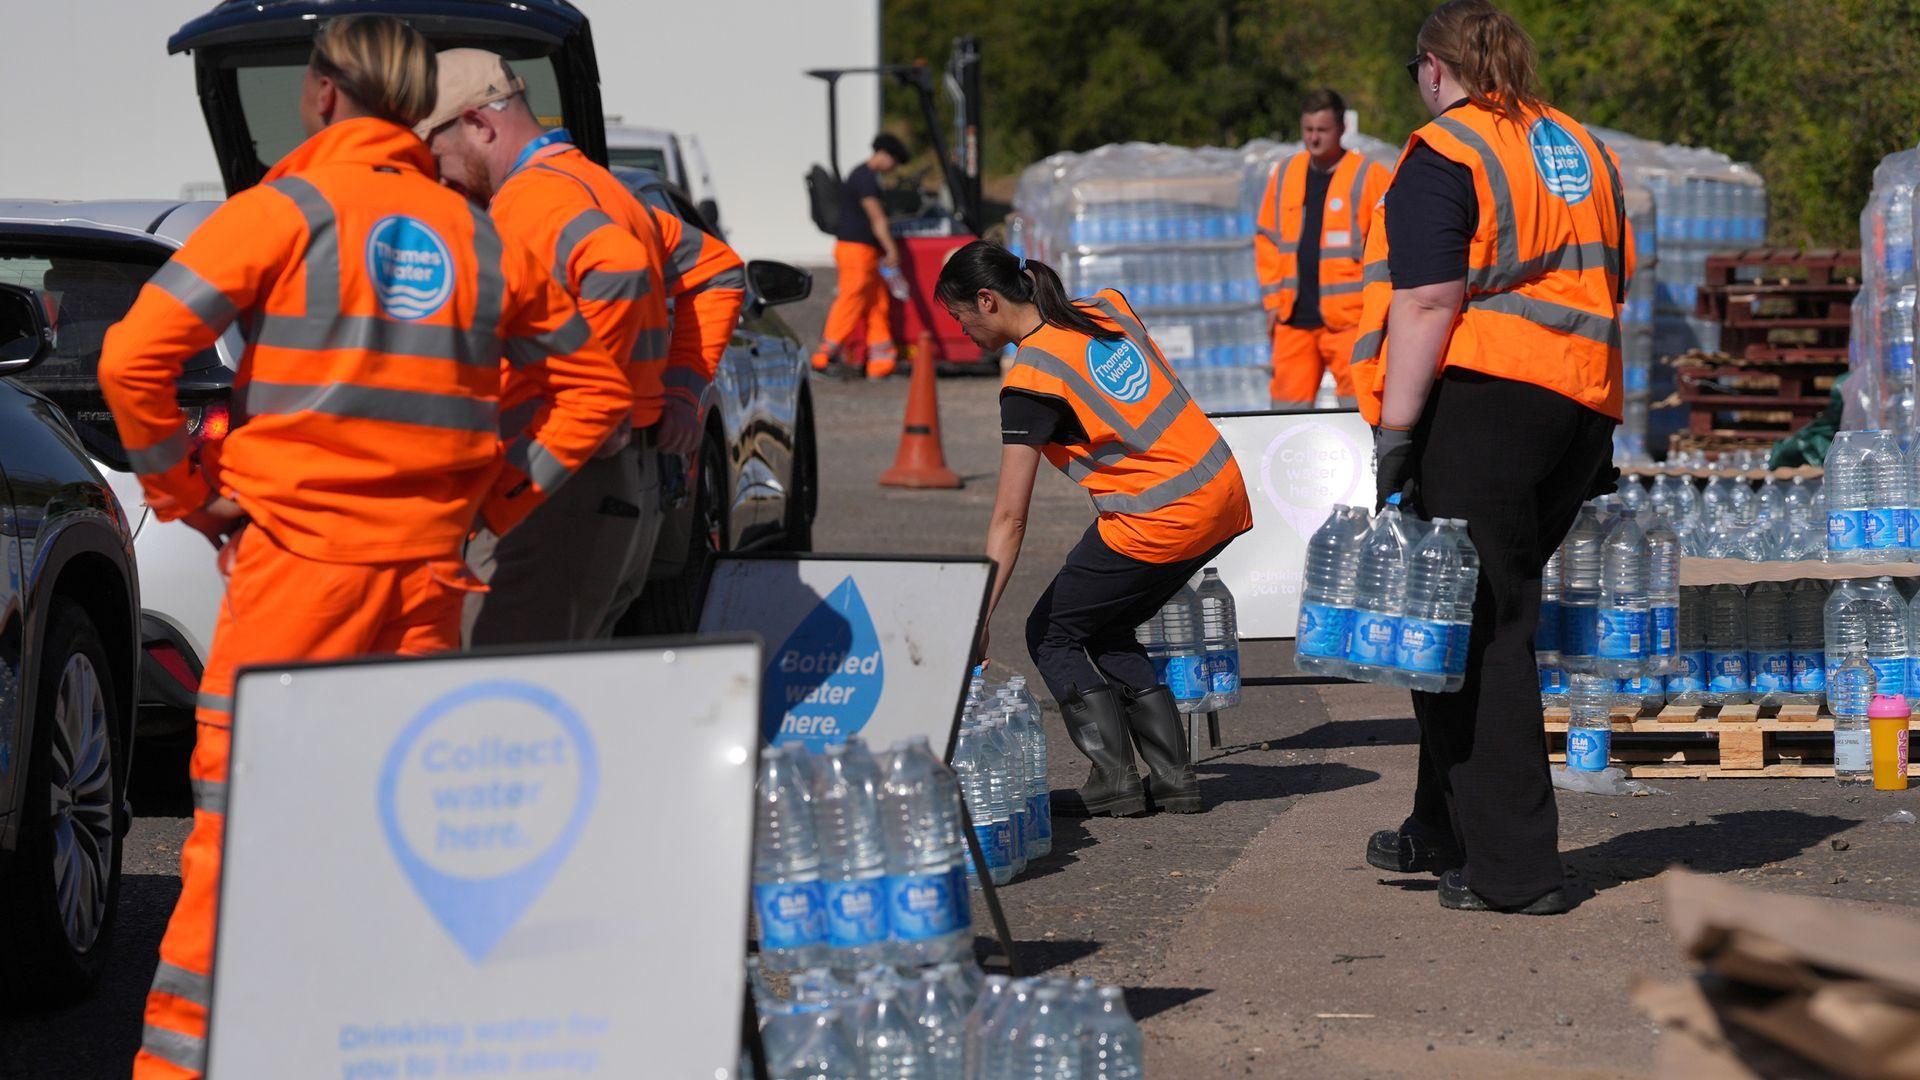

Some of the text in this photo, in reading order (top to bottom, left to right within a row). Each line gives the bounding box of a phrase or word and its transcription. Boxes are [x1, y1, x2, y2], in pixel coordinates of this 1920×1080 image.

[376, 241, 441, 266] Thames
[1095, 343, 1129, 377] Thames
[1107, 356, 1133, 383] Water
[78, 411, 114, 420] HYBR
[1280, 447, 1348, 463] Collect
[1286, 468, 1336, 479] water
[1289, 484, 1334, 497] here.
[1370, 624, 1391, 634] ELM
[1403, 629, 1424, 639] ELM
[780, 651, 879, 675] Bottled
[1724, 660, 1741, 668] ELM
[785, 681, 856, 704] water
[780, 711, 840, 735] here.
[1572, 737, 1588, 746] ELM
[421, 735, 567, 773] Collect
[1897, 729, 1907, 779] SNEAK
[433, 780, 543, 812] water
[436, 818, 533, 853] here.
[339, 1025, 466, 1051] Drinking
